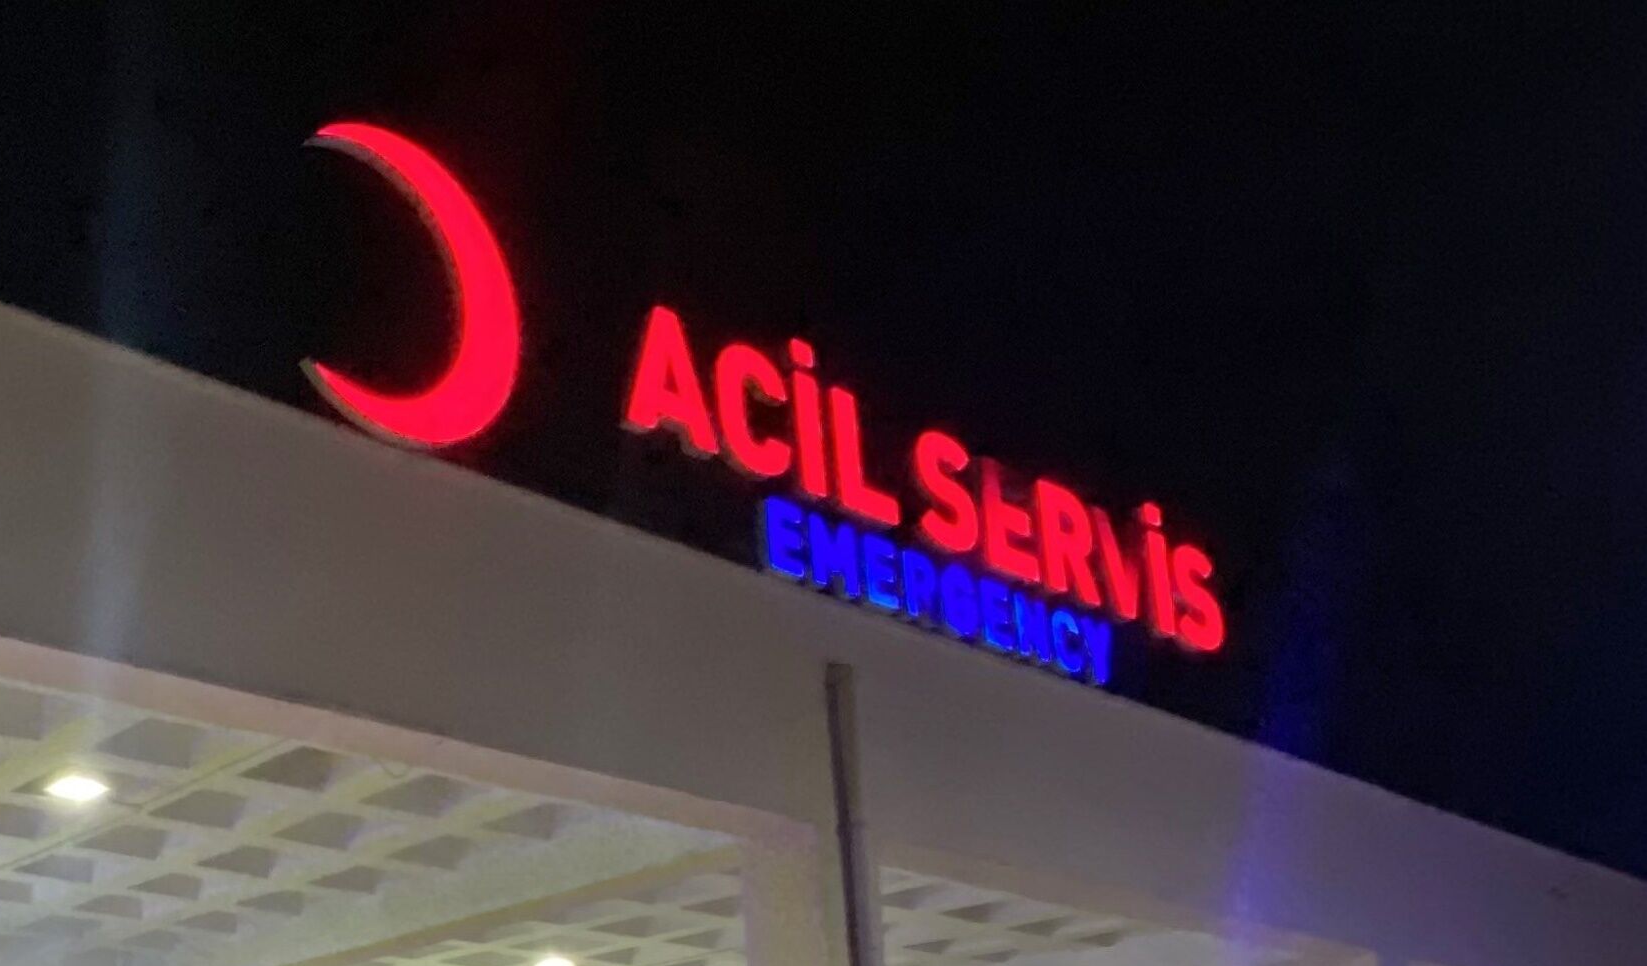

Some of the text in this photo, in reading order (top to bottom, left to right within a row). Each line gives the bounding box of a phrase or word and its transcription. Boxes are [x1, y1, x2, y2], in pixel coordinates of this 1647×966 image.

[622, 304, 1226, 652] ACİL SERVİS
[763, 495, 1113, 685] EMERGENCY
